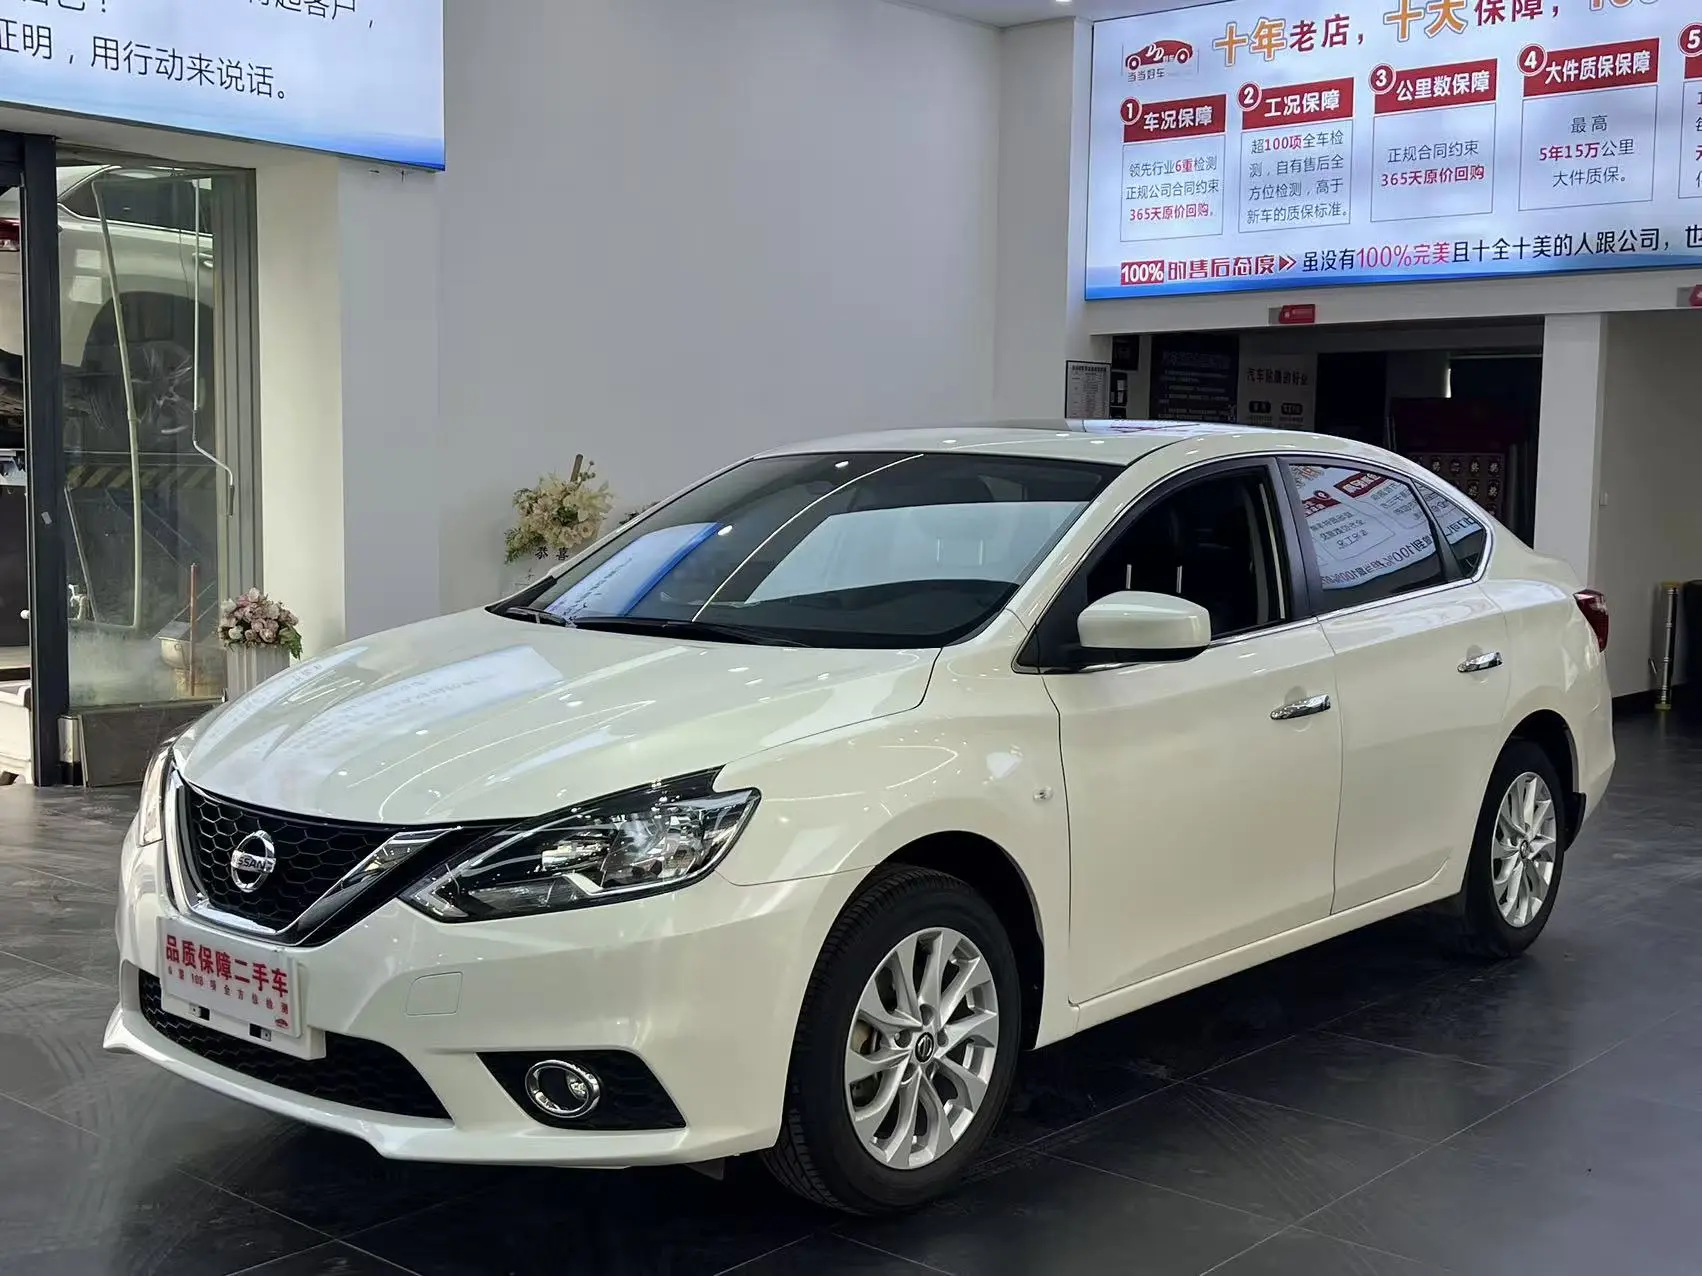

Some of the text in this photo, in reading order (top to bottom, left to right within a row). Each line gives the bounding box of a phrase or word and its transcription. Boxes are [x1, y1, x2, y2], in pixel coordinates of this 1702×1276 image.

[1687, 29, 1702, 49] 5
[1524, 50, 1650, 85] 4 大件质保保障
[1376, 69, 1490, 101] 3 公里数保障
[1244, 86, 1340, 118] 2 工况保障
[1126, 103, 1213, 131] 1 车况保障
[1251, 129, 1344, 154] 超100项全车检
[1387, 140, 1479, 163] 正规合同约束
[1539, 138, 1634, 161] 5年15万公里
[1129, 156, 1217, 177] 领先行业6重检测
[1381, 164, 1485, 187] 365天原价回购
[1552, 166, 1627, 188] 大件质保。
[1126, 179, 1219, 200] 正规公司合同约束
[1247, 201, 1347, 224] 新车的质保标准。
[166, 934, 289, 998] 品质保障二手车
